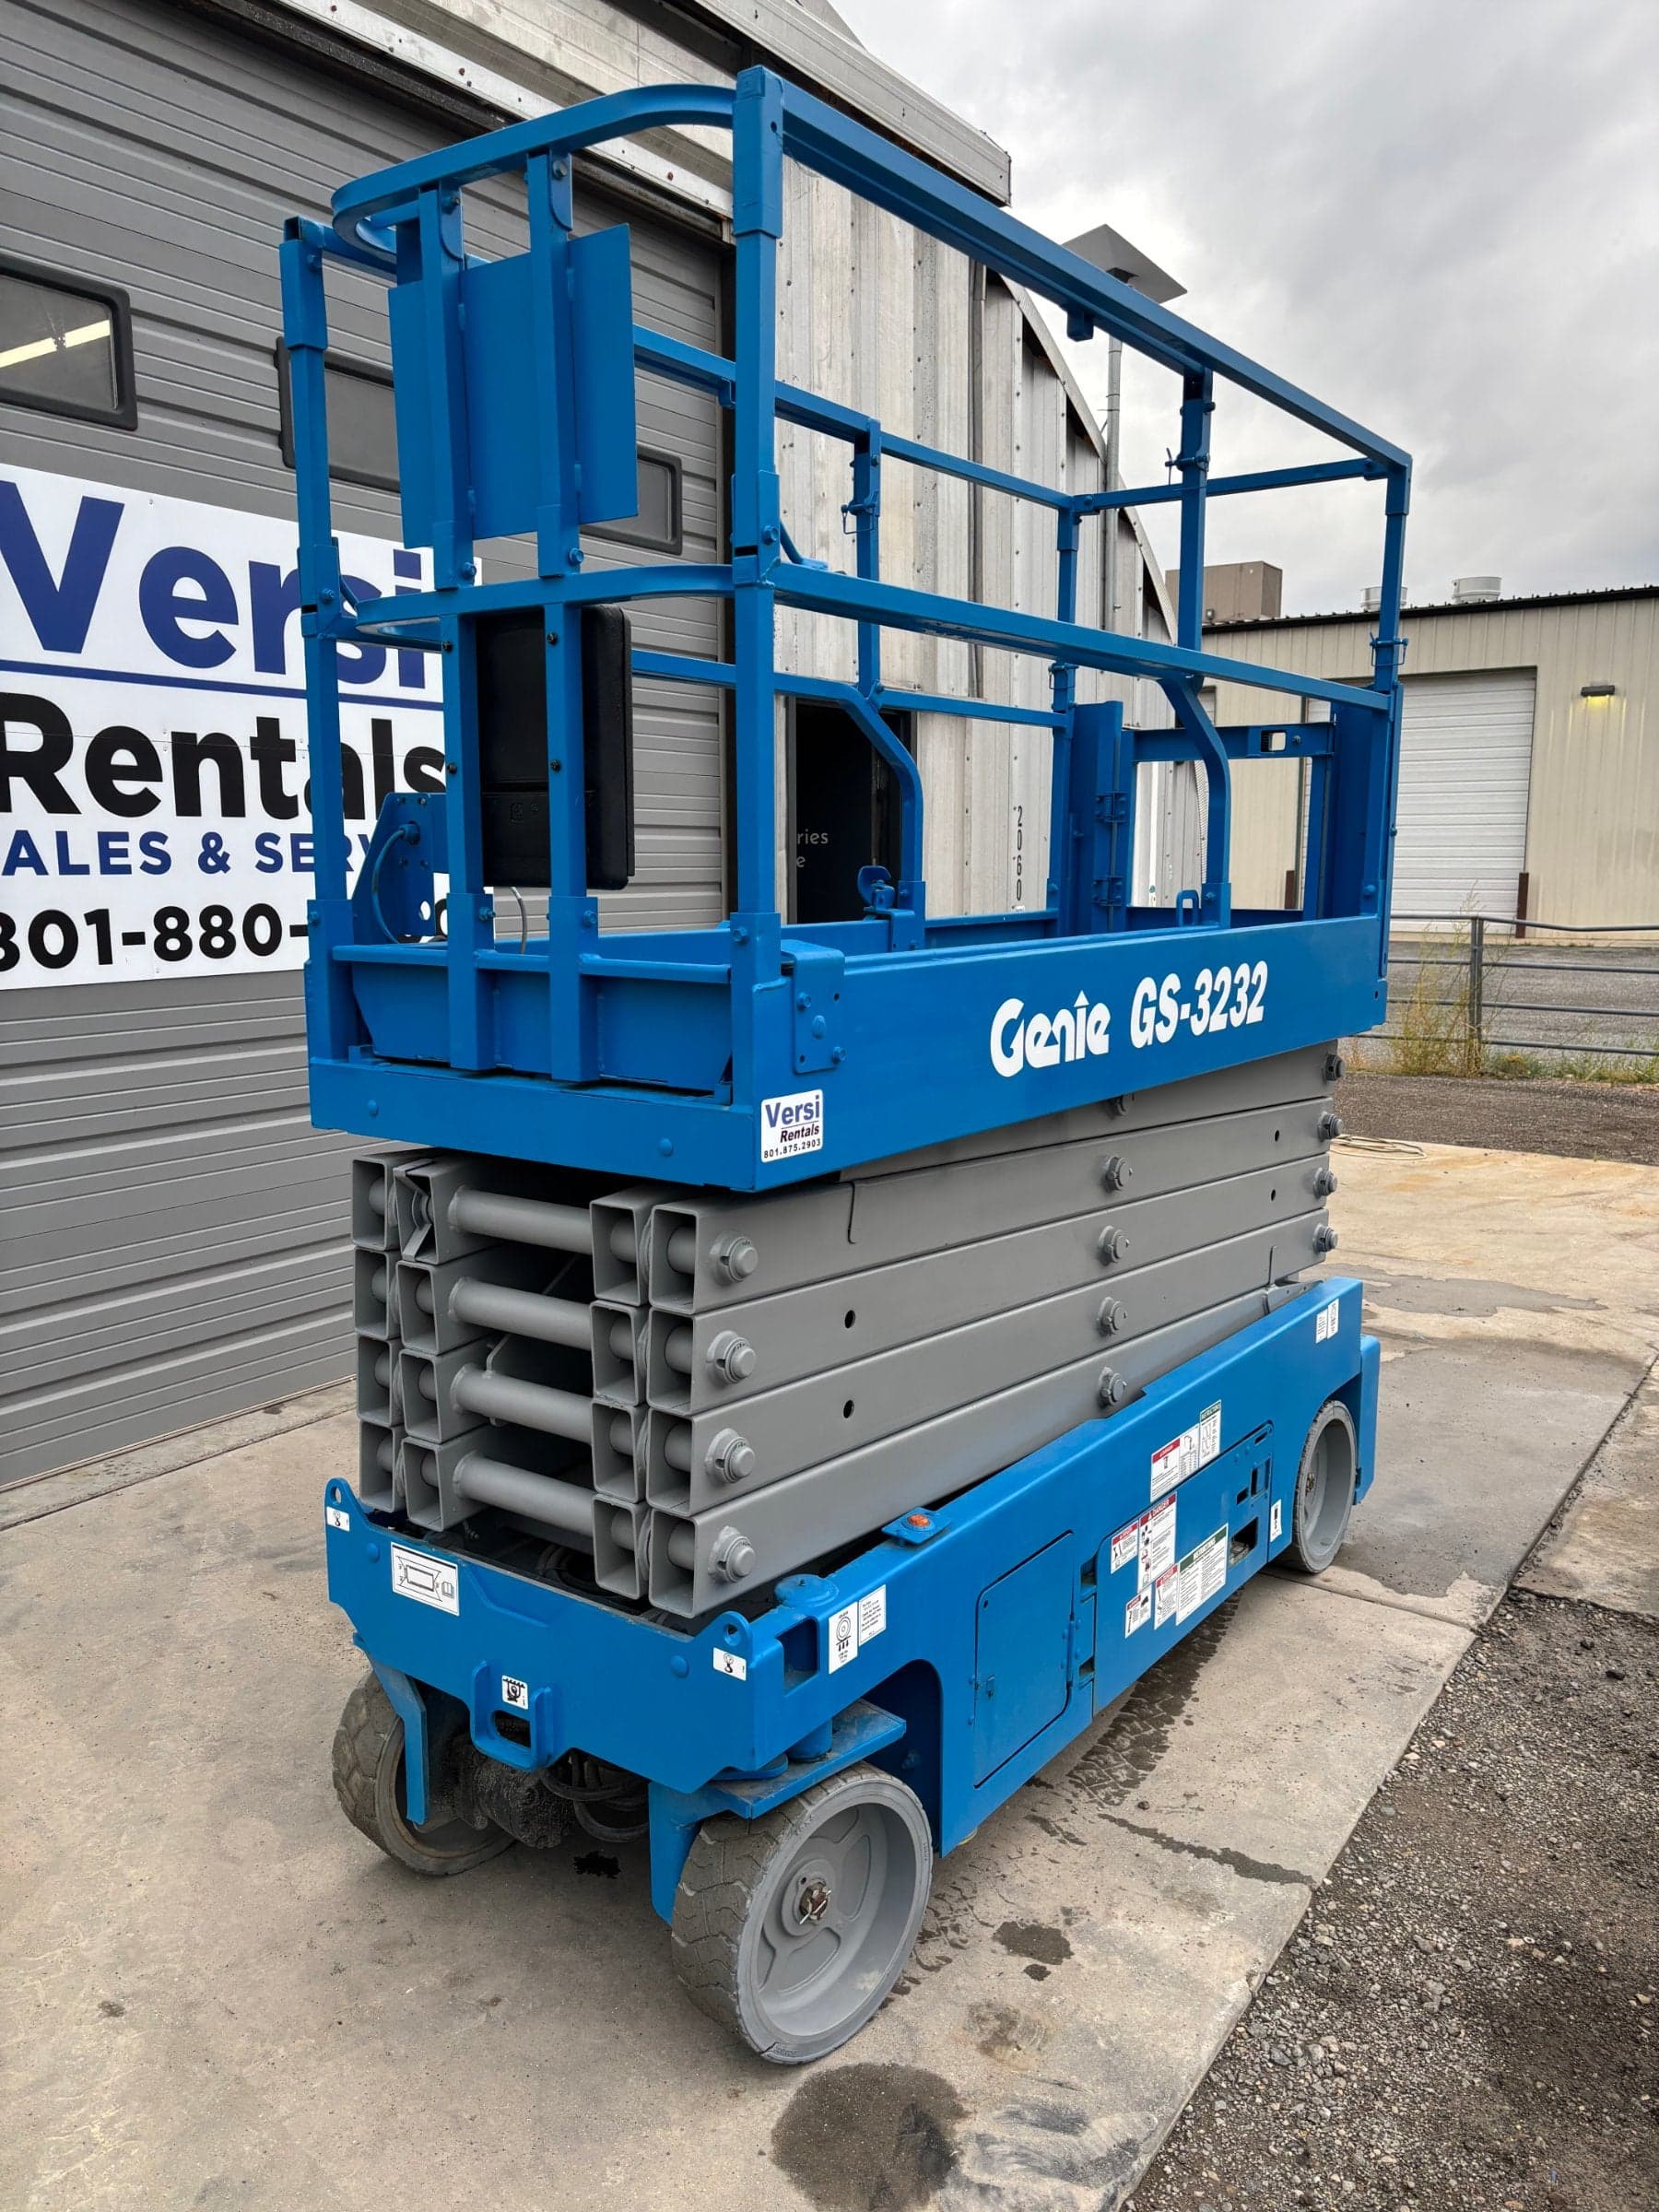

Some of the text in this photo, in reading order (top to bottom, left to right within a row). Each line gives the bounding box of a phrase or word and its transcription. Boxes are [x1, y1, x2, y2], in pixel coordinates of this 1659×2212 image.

[197, 830, 231, 874] &
[991, 960, 1268, 1077] Genie GS-3232
[765, 1095, 819, 1128] Versi
[764, 1138, 820, 1159] 801.875.2903
[780, 1124, 819, 1143] Rentals
